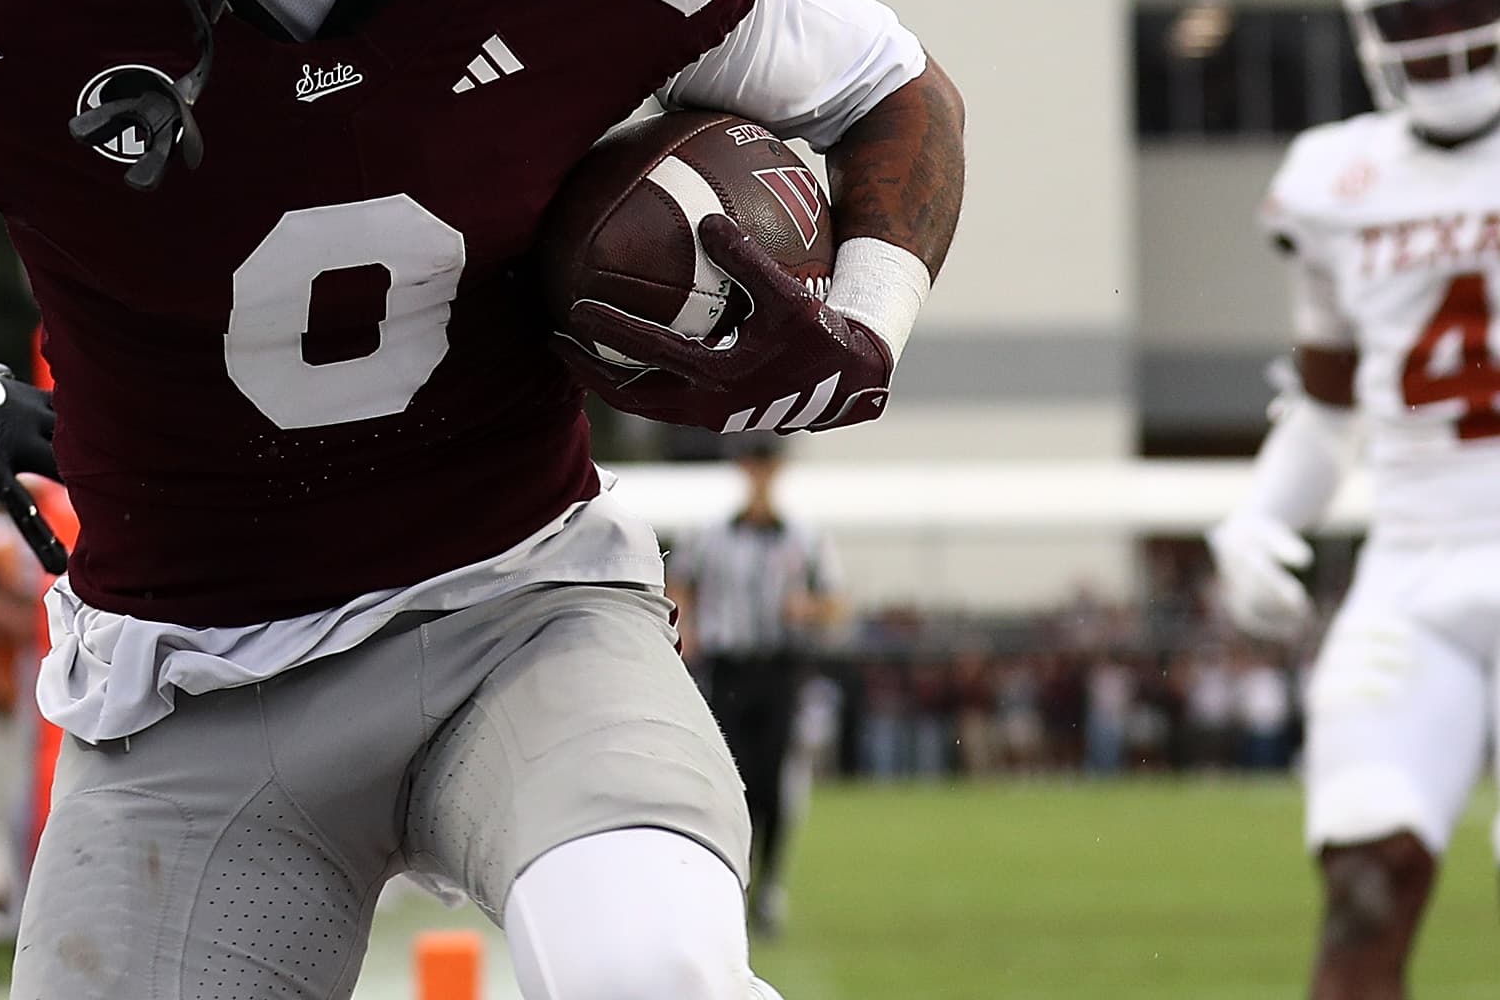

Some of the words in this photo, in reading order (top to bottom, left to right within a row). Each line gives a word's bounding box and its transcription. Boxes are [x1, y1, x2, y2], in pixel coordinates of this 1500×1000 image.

[296, 62, 363, 103] State
[223, 192, 466, 430] 0
[1401, 272, 1500, 441] 4
